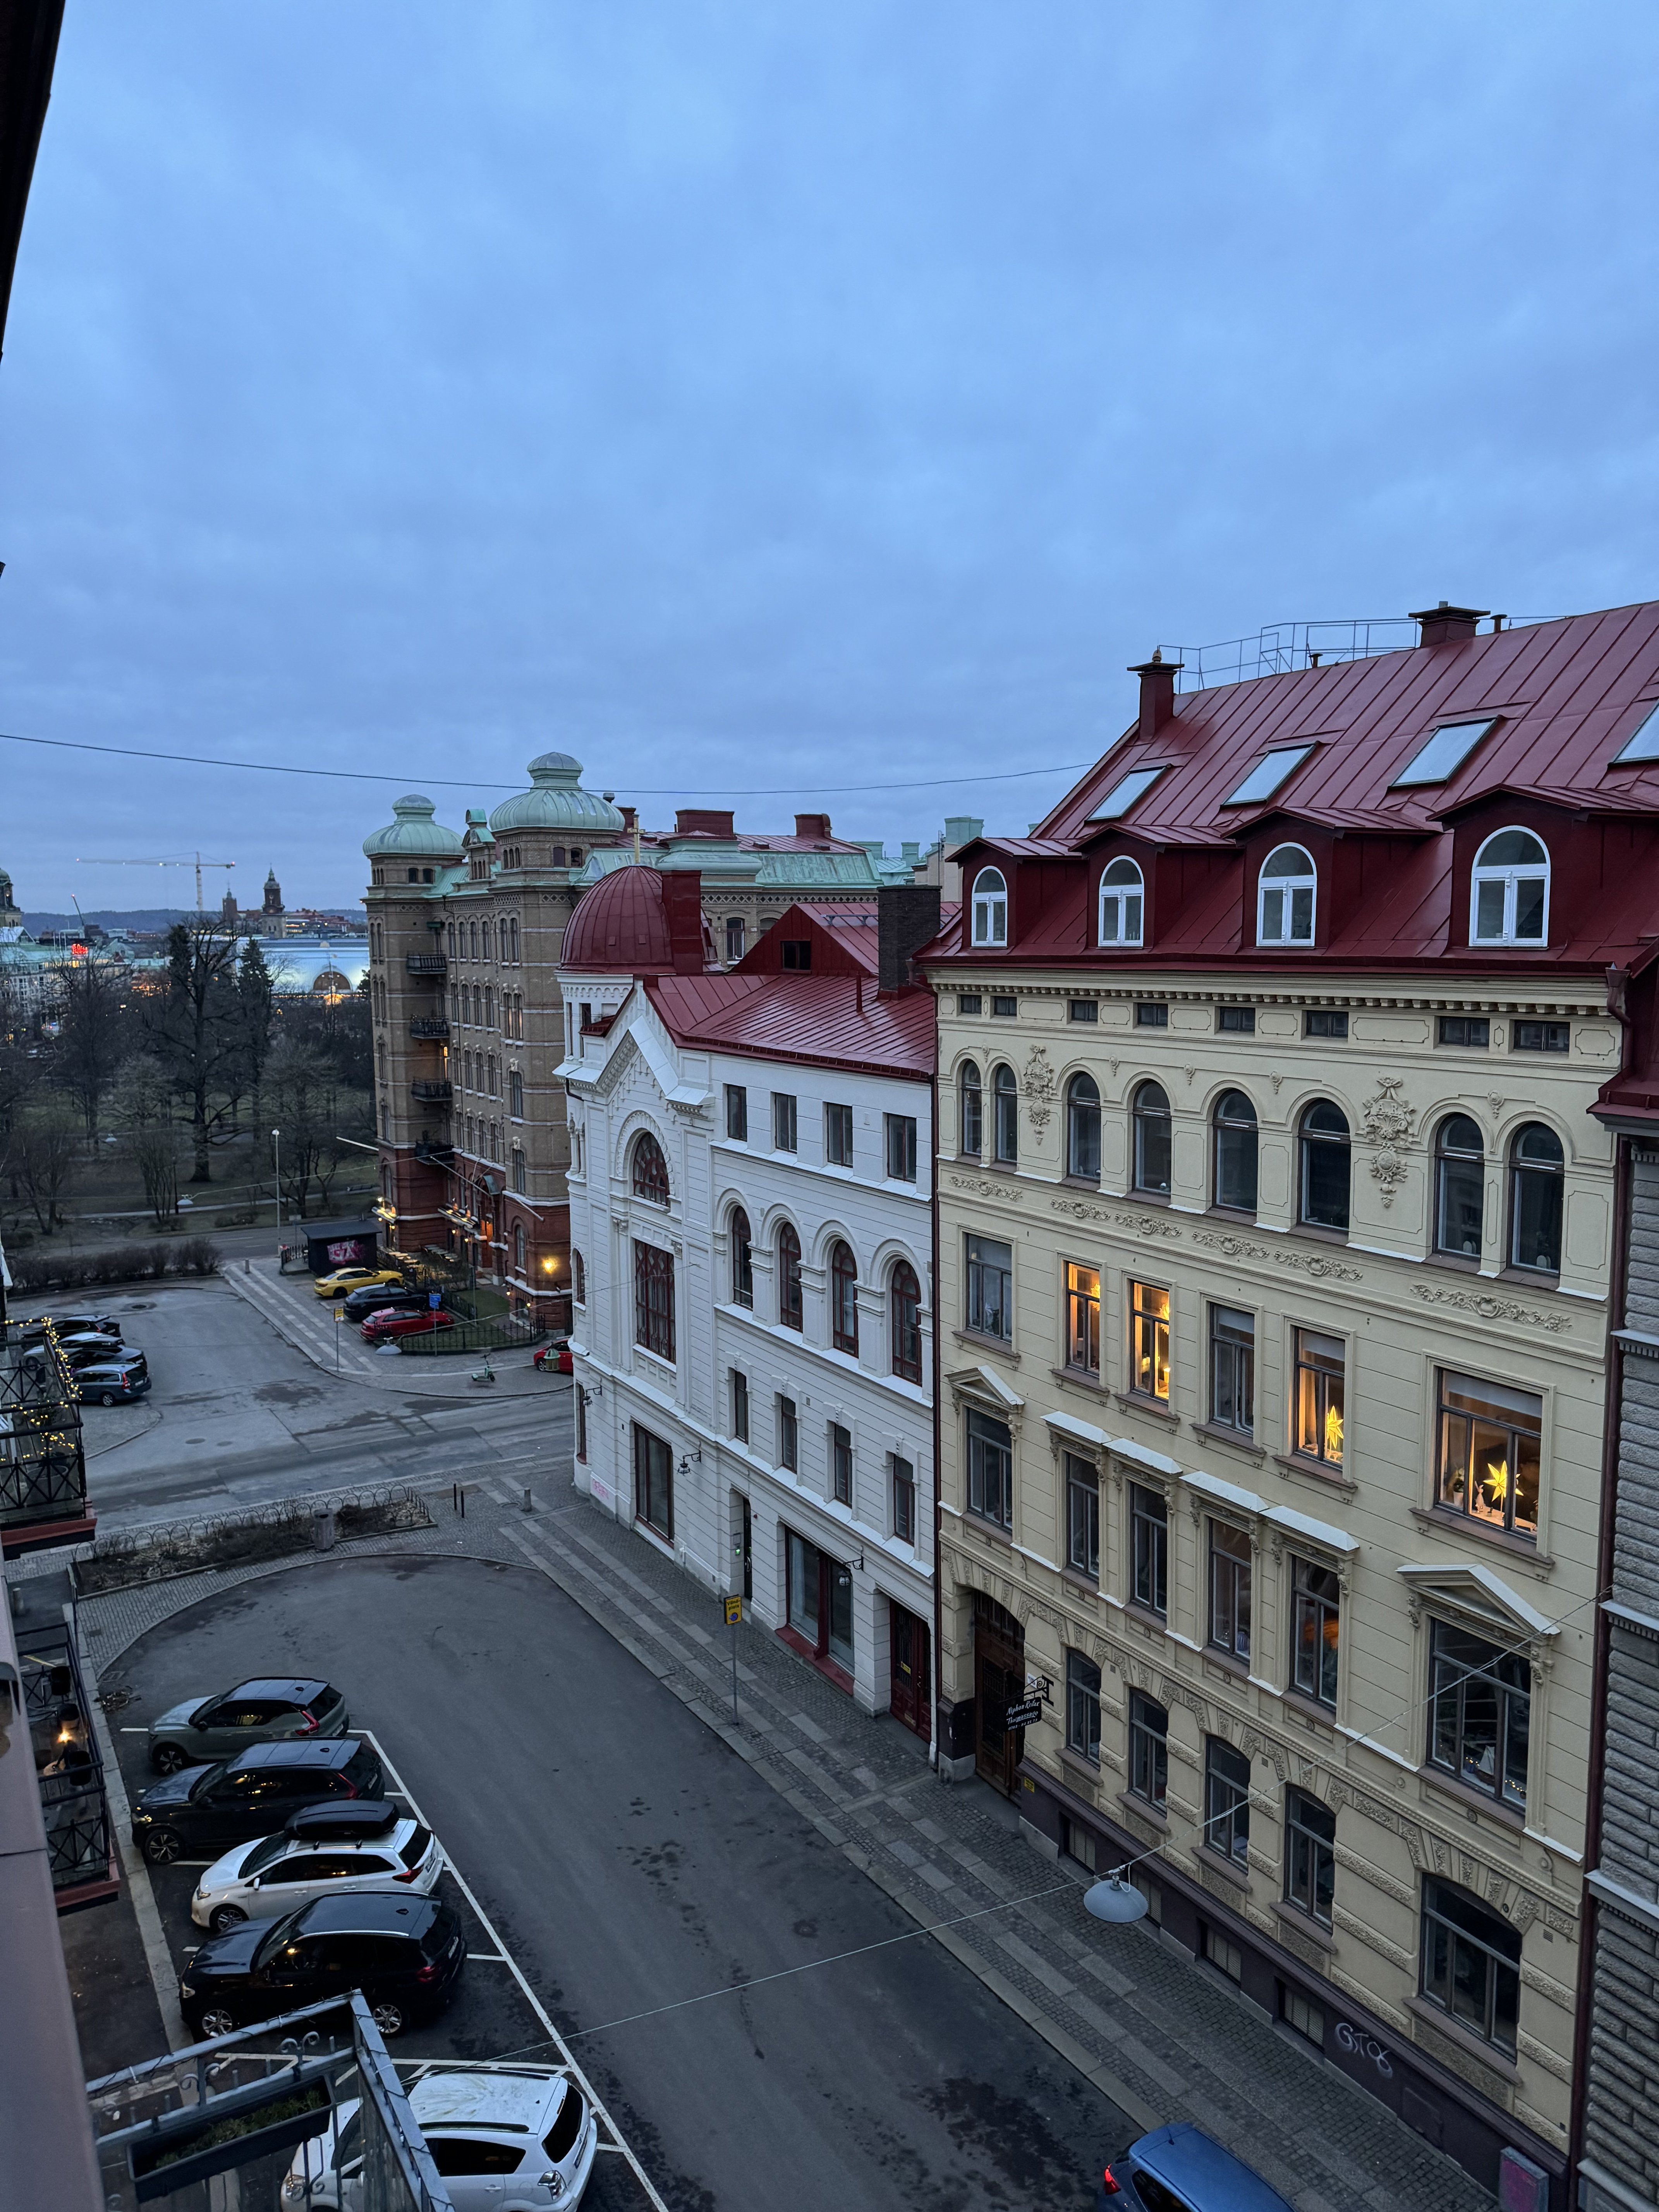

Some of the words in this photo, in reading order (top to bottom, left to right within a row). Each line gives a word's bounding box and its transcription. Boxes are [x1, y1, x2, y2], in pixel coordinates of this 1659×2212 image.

[1006, 1704, 1025, 1716] Niphon
[1025, 1699, 1040, 1709] Relax
[1006, 1711, 1038, 1725] Thaimassage
